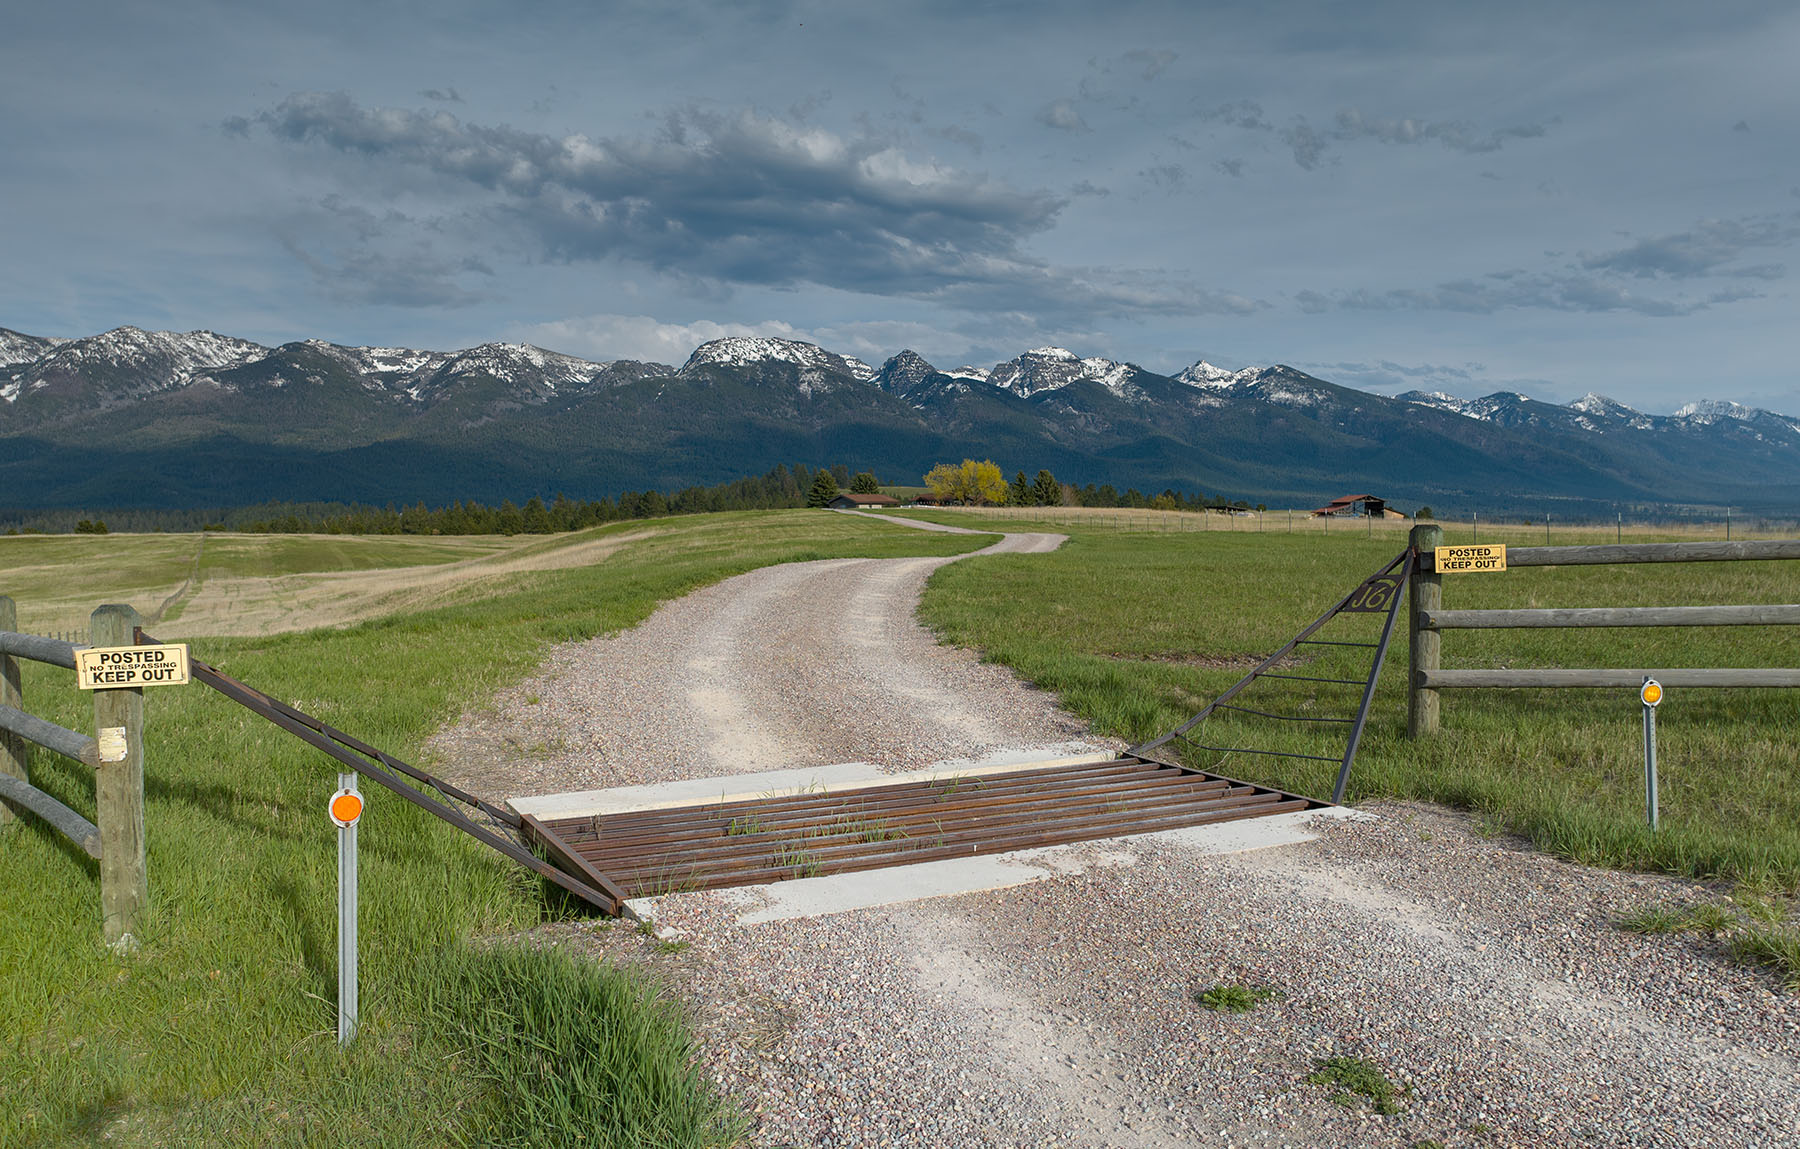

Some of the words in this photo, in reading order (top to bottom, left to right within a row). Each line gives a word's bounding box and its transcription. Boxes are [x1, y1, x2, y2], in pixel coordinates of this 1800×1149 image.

[1449, 548, 1491, 557] POSTED
[1444, 561, 1472, 569] KEEP
[1475, 560, 1497, 568] OUT
[100, 651, 165, 664] POSTED
[107, 662, 177, 670] TRESPASSING
[93, 670, 136, 683] KEEP
[142, 669, 174, 681] OUT
